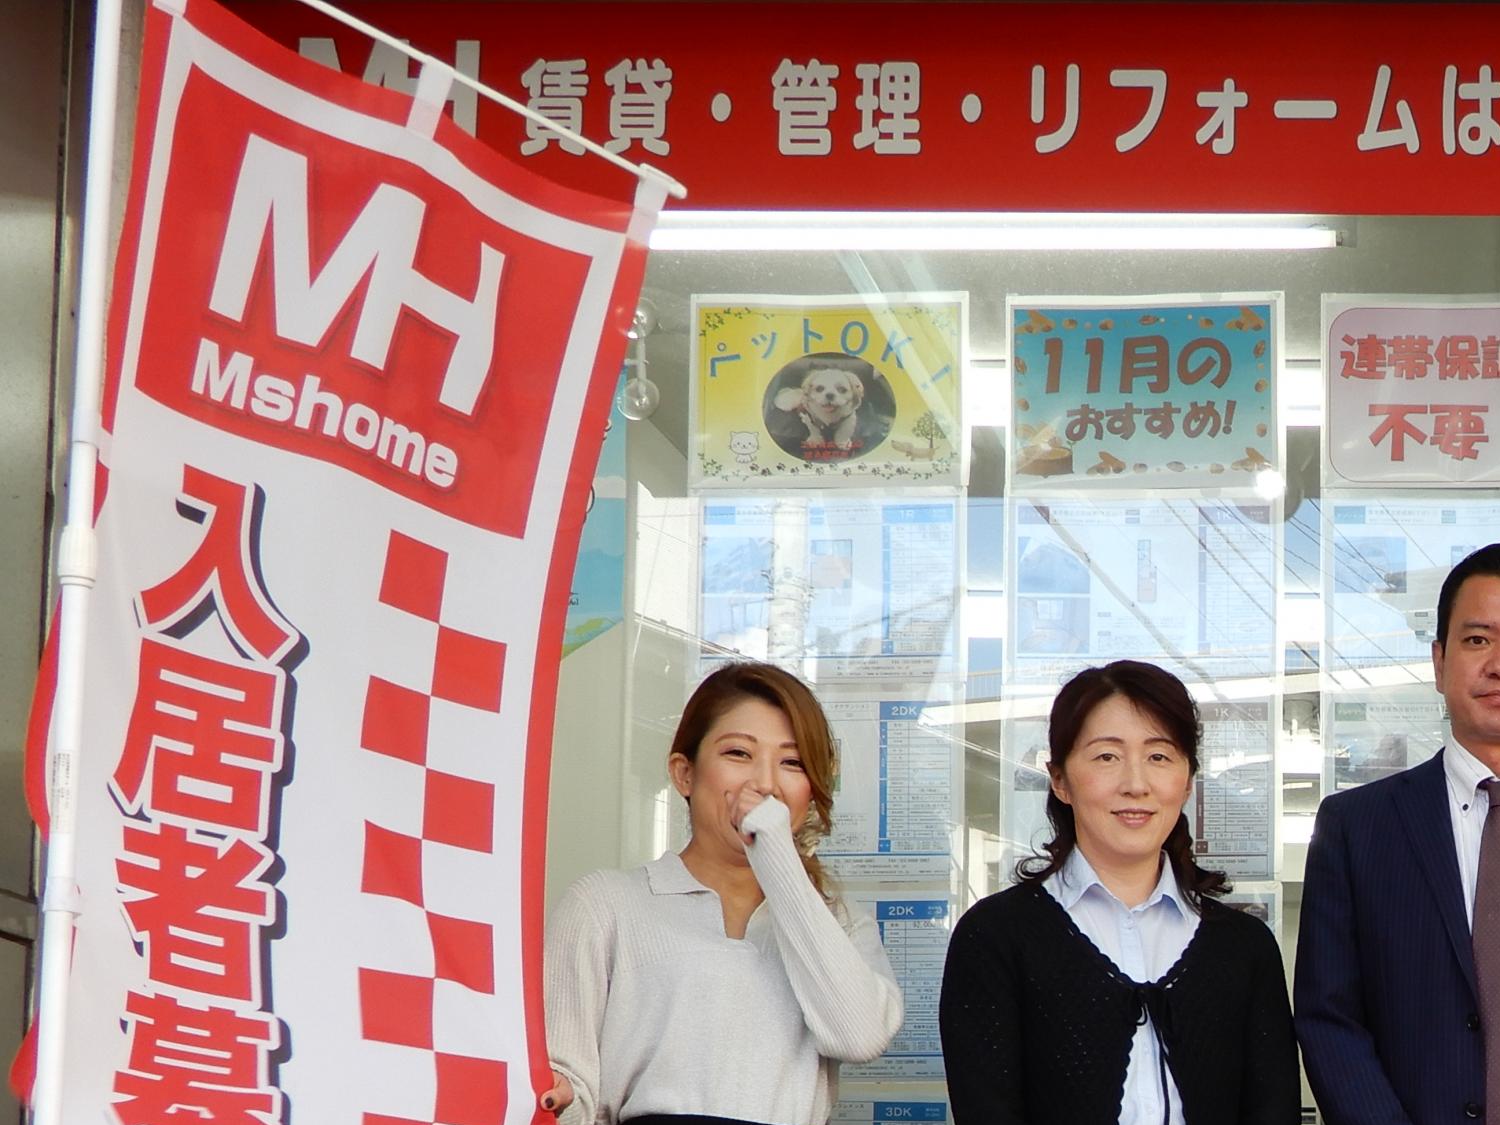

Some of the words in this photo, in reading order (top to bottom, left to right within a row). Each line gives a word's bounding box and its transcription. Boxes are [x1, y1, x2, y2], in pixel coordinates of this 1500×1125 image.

[208, 133, 506, 417] MH
[1043, 335, 1233, 394] 11月の
[190, 337, 459, 490] Mshome
[891, 705, 918, 717] 2DK
[888, 905, 915, 917] 2DK
[885, 1106, 913, 1118] 3DK
